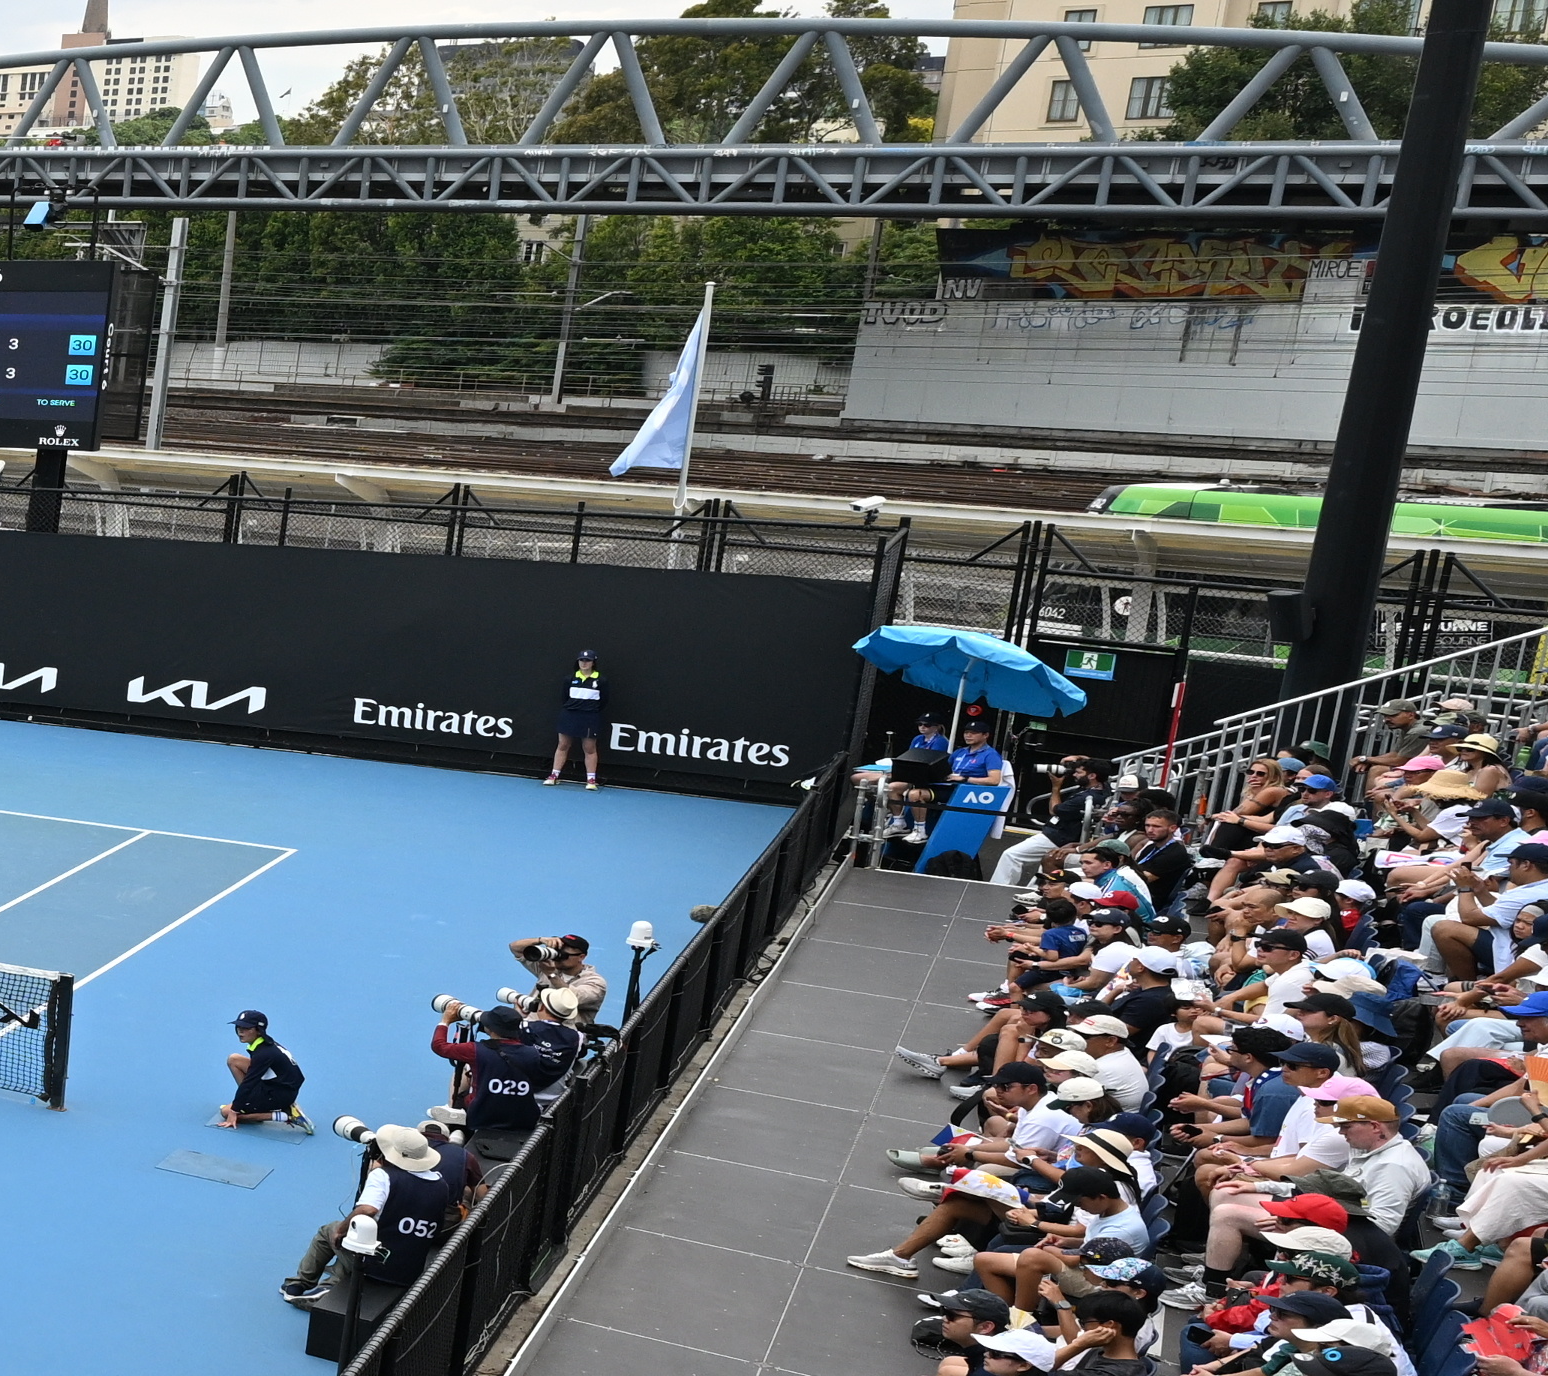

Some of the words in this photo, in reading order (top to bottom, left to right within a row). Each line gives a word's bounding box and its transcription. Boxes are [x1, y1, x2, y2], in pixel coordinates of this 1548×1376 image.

[9, 338, 19, 350] 3
[72, 339, 93, 351] 30
[103, 323, 114, 375] Court
[5, 368, 16, 379] 3
[69, 369, 89, 381] 30
[101, 379, 108, 390] 6
[50, 399, 75, 407] SERVE
[39, 437, 79, 447] ROLEX
[354, 697, 514, 740] Emirates
[610, 723, 791, 769] Emirates
[963, 791, 996, 804] AO
[488, 1078, 530, 1096] 029
[398, 1216, 439, 1239] 052
